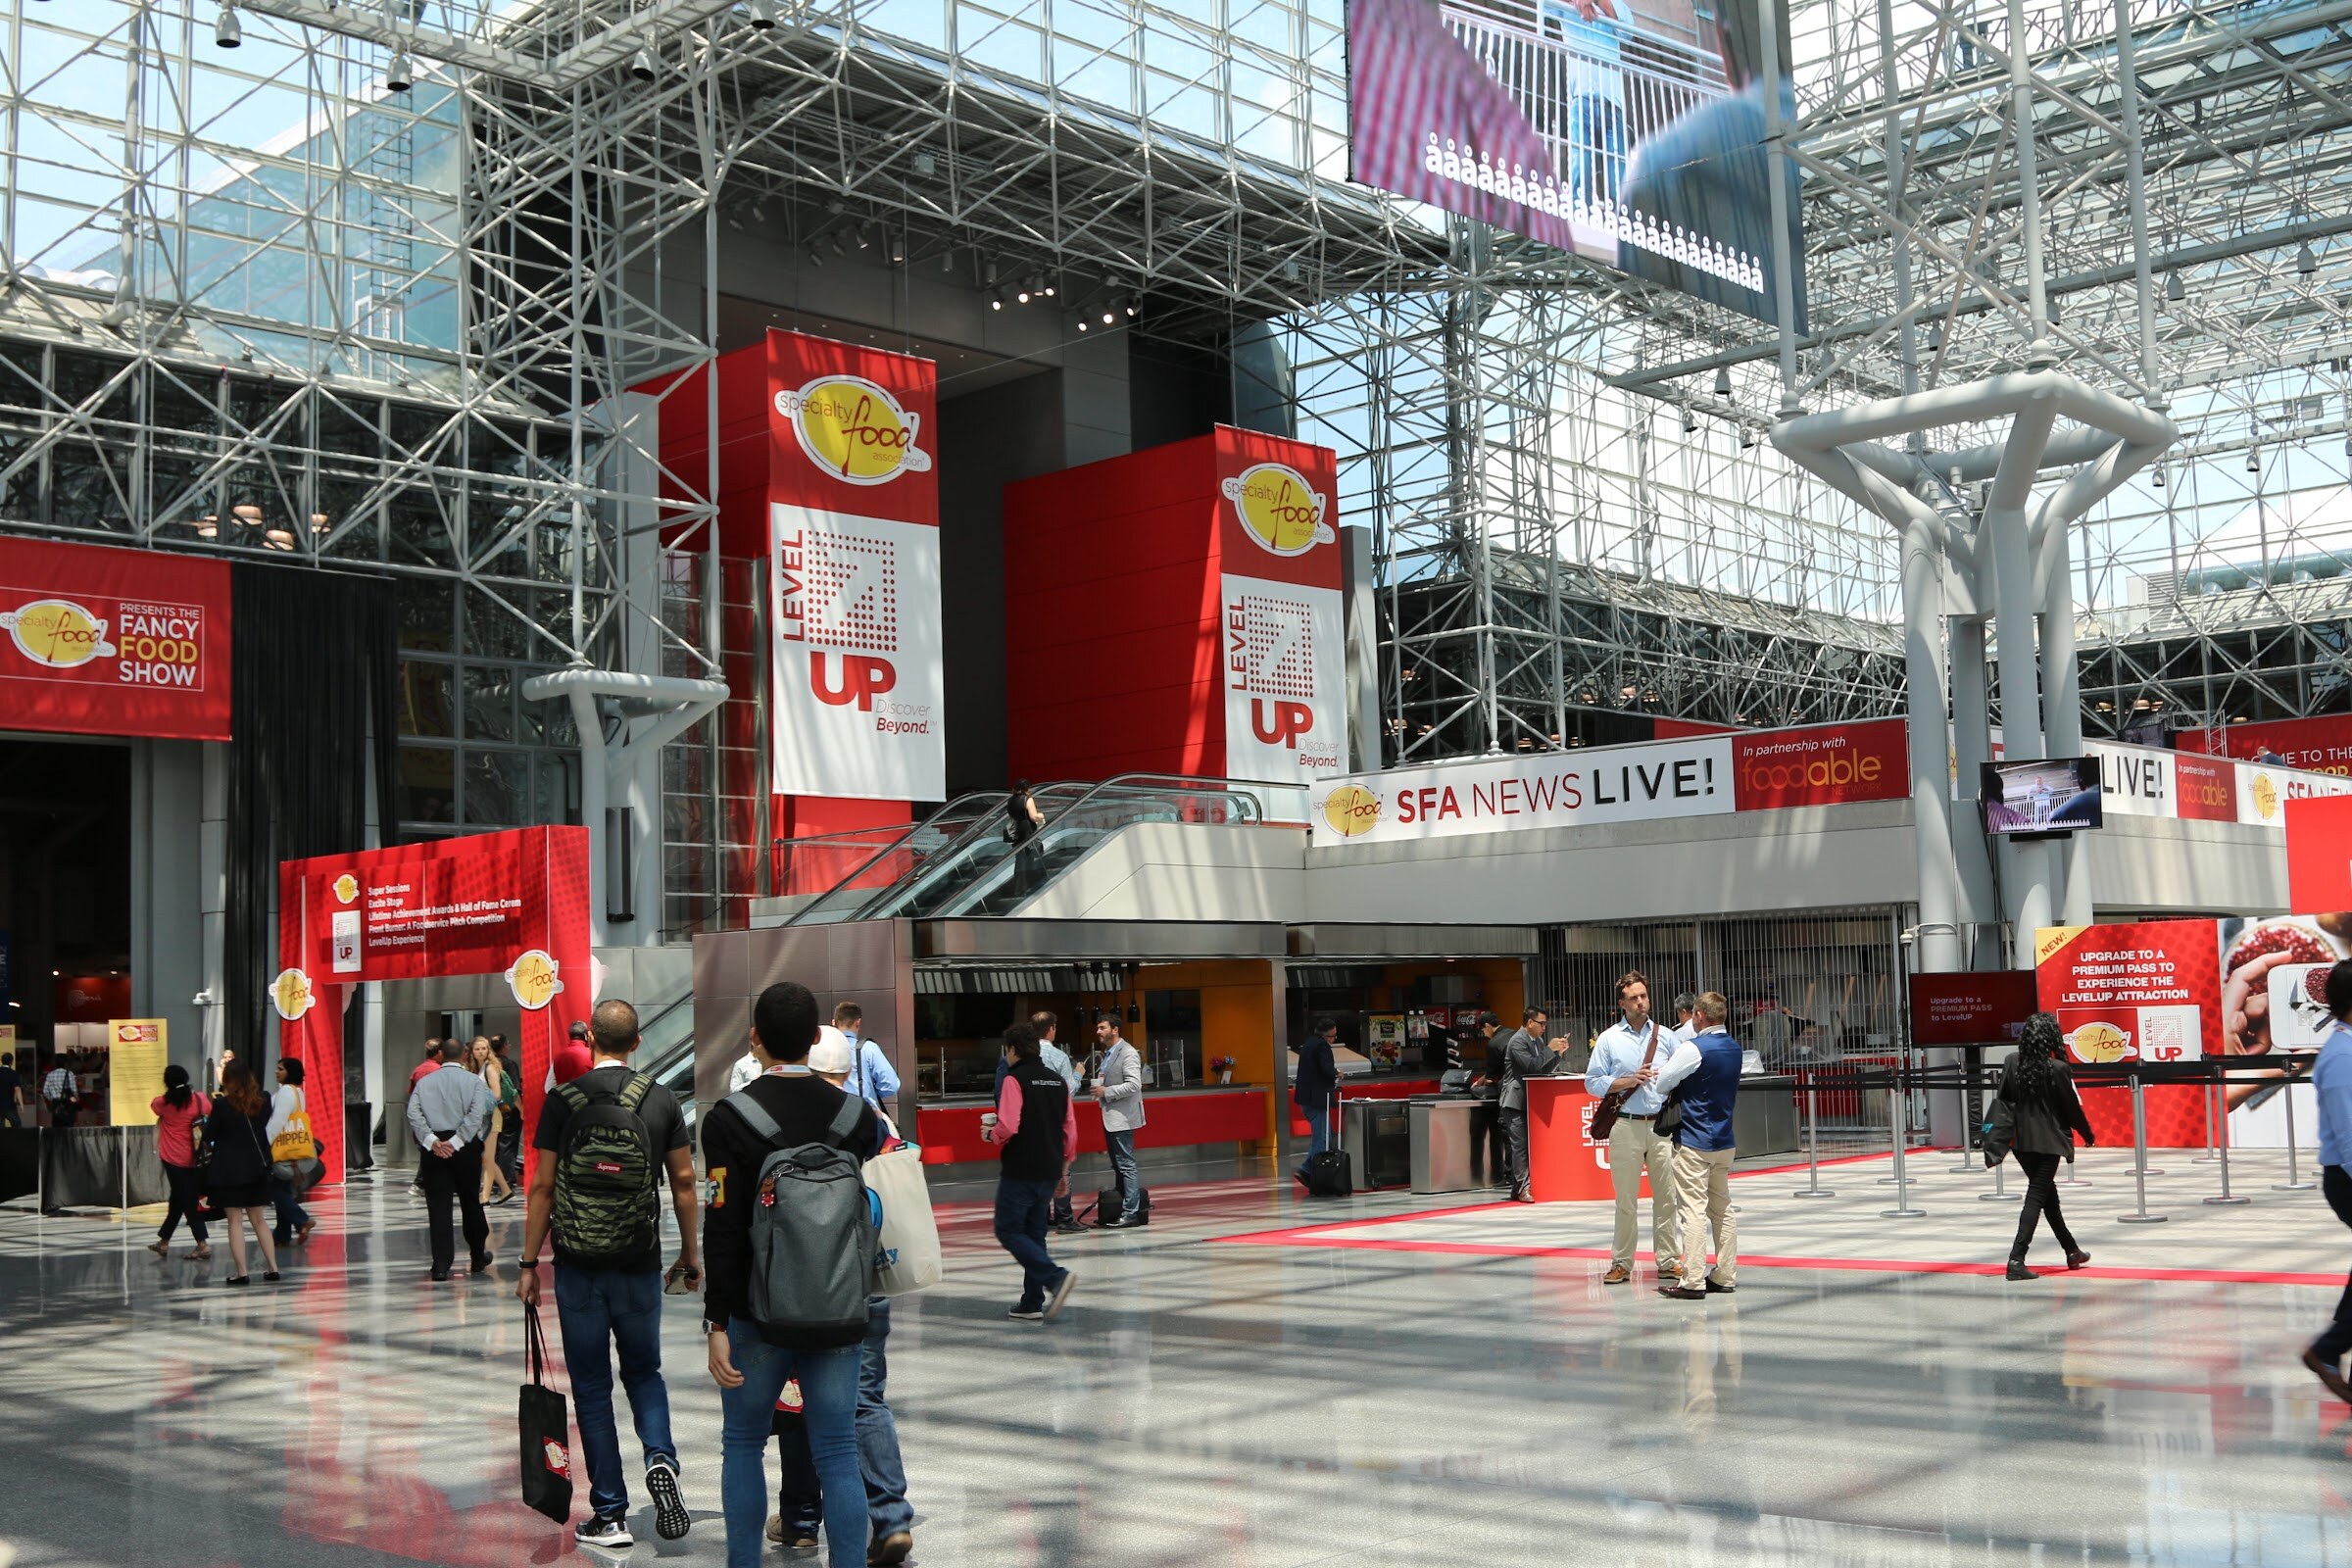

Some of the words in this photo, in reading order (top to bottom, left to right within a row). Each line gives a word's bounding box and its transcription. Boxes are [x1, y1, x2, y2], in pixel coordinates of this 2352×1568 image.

[780, 395, 853, 422] specialty
[842, 395, 915, 477] food
[1225, 481, 1279, 504] specialty
[1270, 479, 1322, 550] food
[782, 529, 805, 642] LEVEL
[0, 614, 57, 629] specialty
[120, 603, 175, 616] PRESENTS
[178, 608, 199, 619] THE
[47, 611, 104, 663] food
[120, 613, 200, 640] FANCY
[120, 636, 199, 664] FOOD
[1229, 595, 1248, 690] LEVEL
[119, 661, 197, 687] SHOW
[810, 651, 897, 712] UP
[875, 699, 931, 716] Discover
[876, 717, 931, 736] Beyond.
[1251, 698, 1314, 749] UP
[1298, 737, 1340, 753] Discover
[1743, 745, 1756, 758] In
[1756, 739, 1819, 758] partnership
[1822, 736, 1846, 749] with
[1298, 754, 1340, 768] Beyond.
[2300, 750, 2323, 763] TO
[1741, 748, 1883, 792] foodable
[2101, 754, 2164, 800] LIVE!
[1397, 785, 1463, 824] SFA
[1473, 773, 1583, 818] NEWS
[1592, 758, 1714, 806] LIVE!
[1312, 797, 1350, 811] specialty
[1345, 790, 1384, 839] food
[368, 886, 385, 897] Super
[385, 884, 411, 894] Sessions
[368, 911, 391, 921] Lifetime
[392, 907, 431, 919] Achievement
[431, 904, 455, 914] Awards
[454, 903, 460, 912] &
[460, 902, 472, 911] Hall
[473, 901, 480, 910] of
[481, 900, 499, 910] Fame
[386, 898, 404, 907] Stage
[413, 918, 449, 930] Foodservice
[450, 915, 466, 926] Pitch
[466, 913, 505, 925] Competition
[368, 936, 392, 947] LevelUp
[393, 934, 424, 946] Experience
[2040, 932, 2068, 956] NEW!
[340, 947, 353, 959] UP
[2081, 952, 2135, 962] UPGRADE
[2137, 950, 2154, 959] TO
[2156, 950, 2165, 959] A
[2072, 965, 2125, 975] PREMIUM
[2127, 963, 2156, 973] PASS
[2159, 962, 2175, 972] TO
[2077, 978, 2148, 989] EXPERIENCE
[2151, 976, 2174, 986] THE
[2062, 992, 2114, 1003] LEVELUP
[2116, 989, 2188, 1001] ATTRACTION
[2064, 1033, 2098, 1044] specialty
[2144, 1016, 2153, 1047] LEVEL
[2093, 1028, 2130, 1063] food
[2155, 1047, 2182, 1062] UP
[1581, 1101, 1594, 1147] LEVEL
[597, 1162, 620, 1172] Supreme
